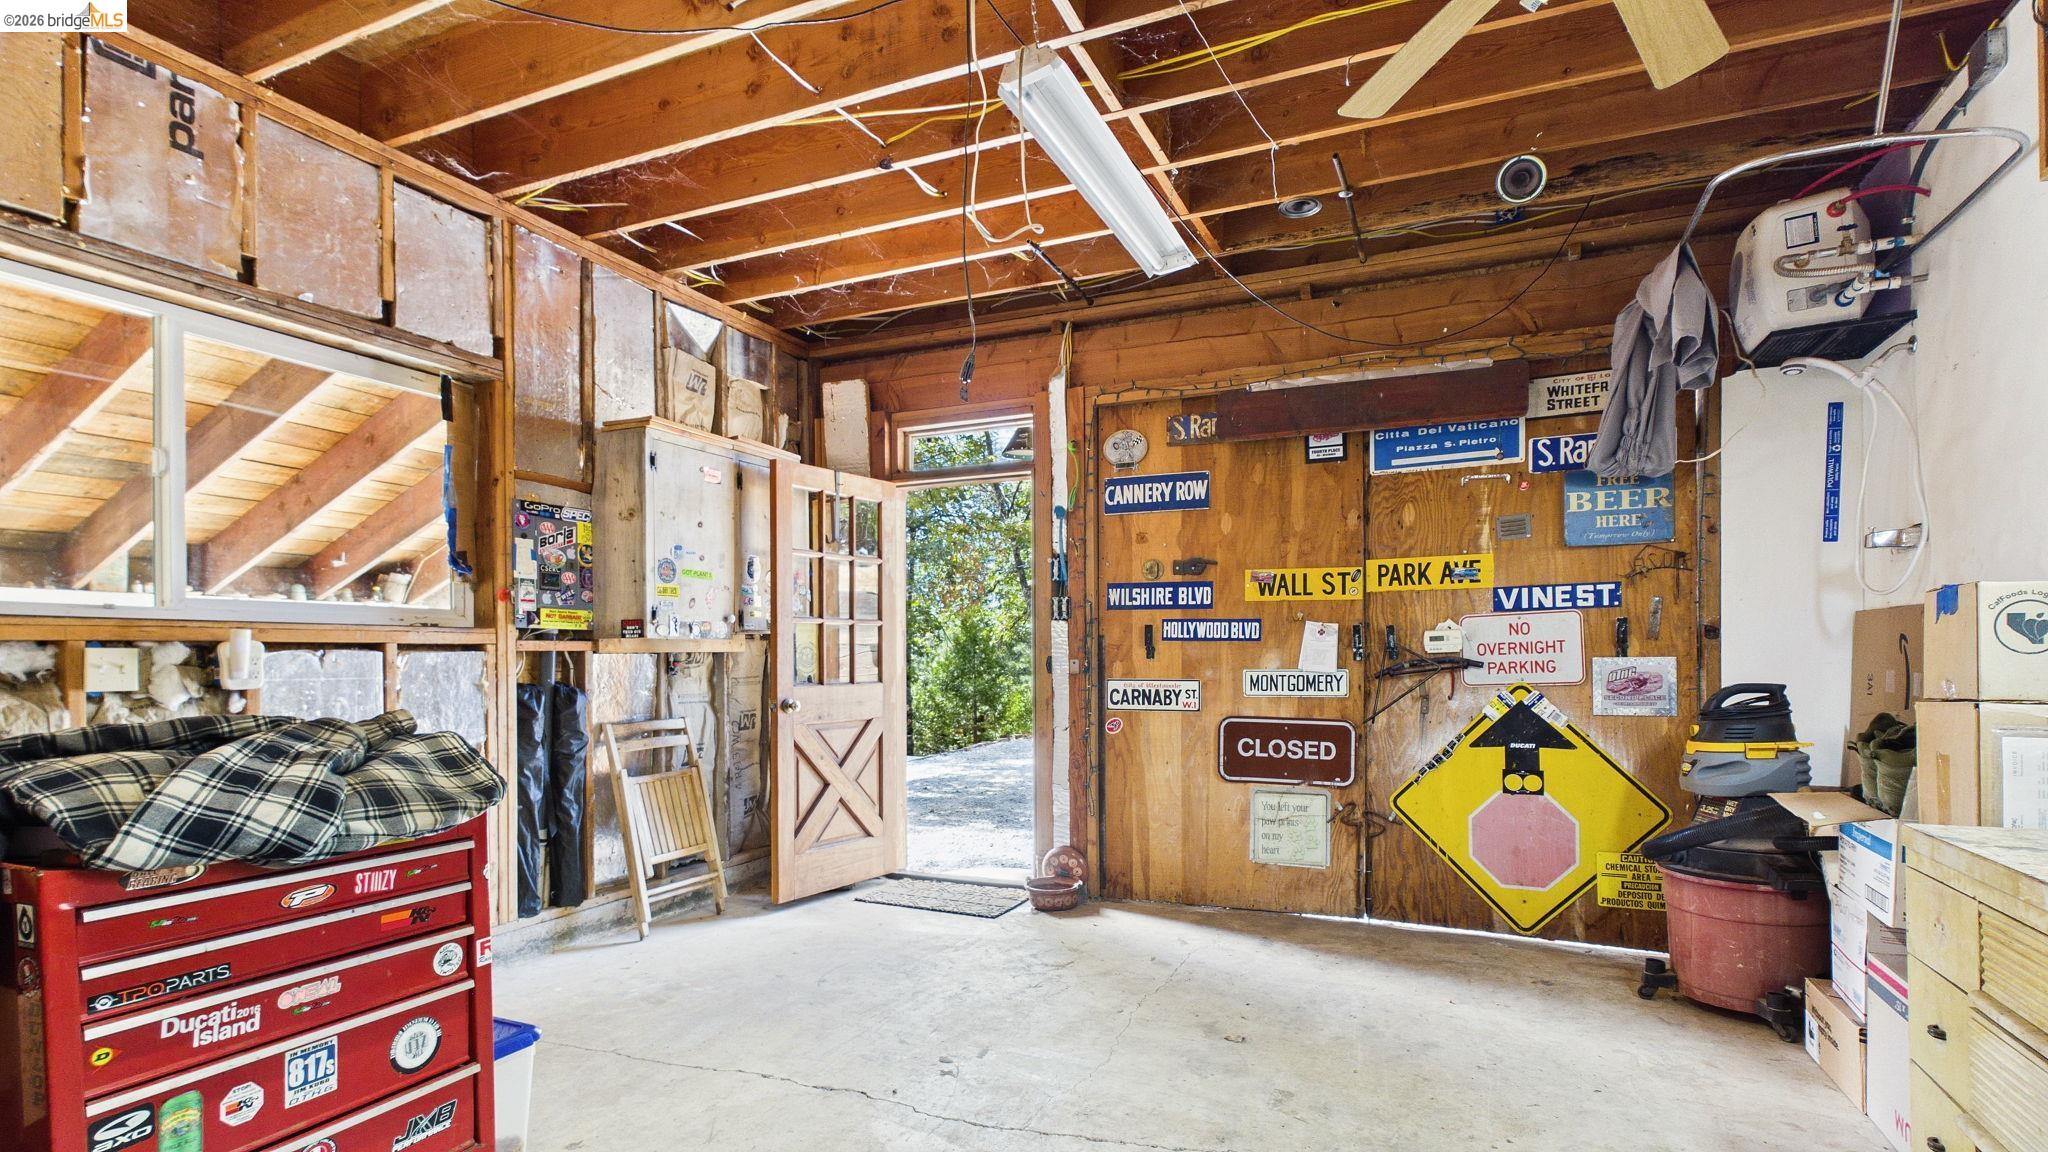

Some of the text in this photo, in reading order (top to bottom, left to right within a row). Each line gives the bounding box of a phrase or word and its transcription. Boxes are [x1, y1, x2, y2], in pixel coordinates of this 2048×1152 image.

[1547, 395, 1600, 411] STREET
[1418, 425, 1442, 436] Del
[1448, 418, 1519, 433] Vaticano
[1396, 436, 1497, 453] Piazza S. Pietro
[1538, 439, 1555, 467] S.
[1105, 479, 1208, 506] CANNERY ROW
[1567, 487, 1673, 513] BEER
[524, 502, 561, 514] GoPro
[1596, 514, 1642, 528] HERE
[1377, 562, 1432, 587] PARK
[1256, 571, 1314, 598] WALL
[1108, 586, 1212, 607] WILSHIRE BLVD
[1988, 590, 2028, 610] CalFoods
[1163, 621, 1260, 640] HOLLYWOOD BLVD
[1508, 622, 1531, 636] NO
[1476, 639, 1566, 657] OVERNIGHT
[1487, 660, 1557, 675] PARKING
[1249, 674, 1344, 693] MONTGOMERY
[1110, 688, 1198, 706] CARNABY ST.
[1237, 738, 1337, 761] CLOSED
[1261, 801, 1276, 811] You
[1292, 803, 1310, 813] your
[1621, 854, 1657, 863] CAUTI
[1605, 862, 1663, 874] CHEMICAL STO
[1631, 873, 1651, 882] AREA
[1600, 897, 1644, 908] PRODUCTOS
[1617, 890, 1665, 901] DEPOSITO DE
[160, 1002, 238, 1039] Ducati
[192, 1011, 261, 1048] Island
